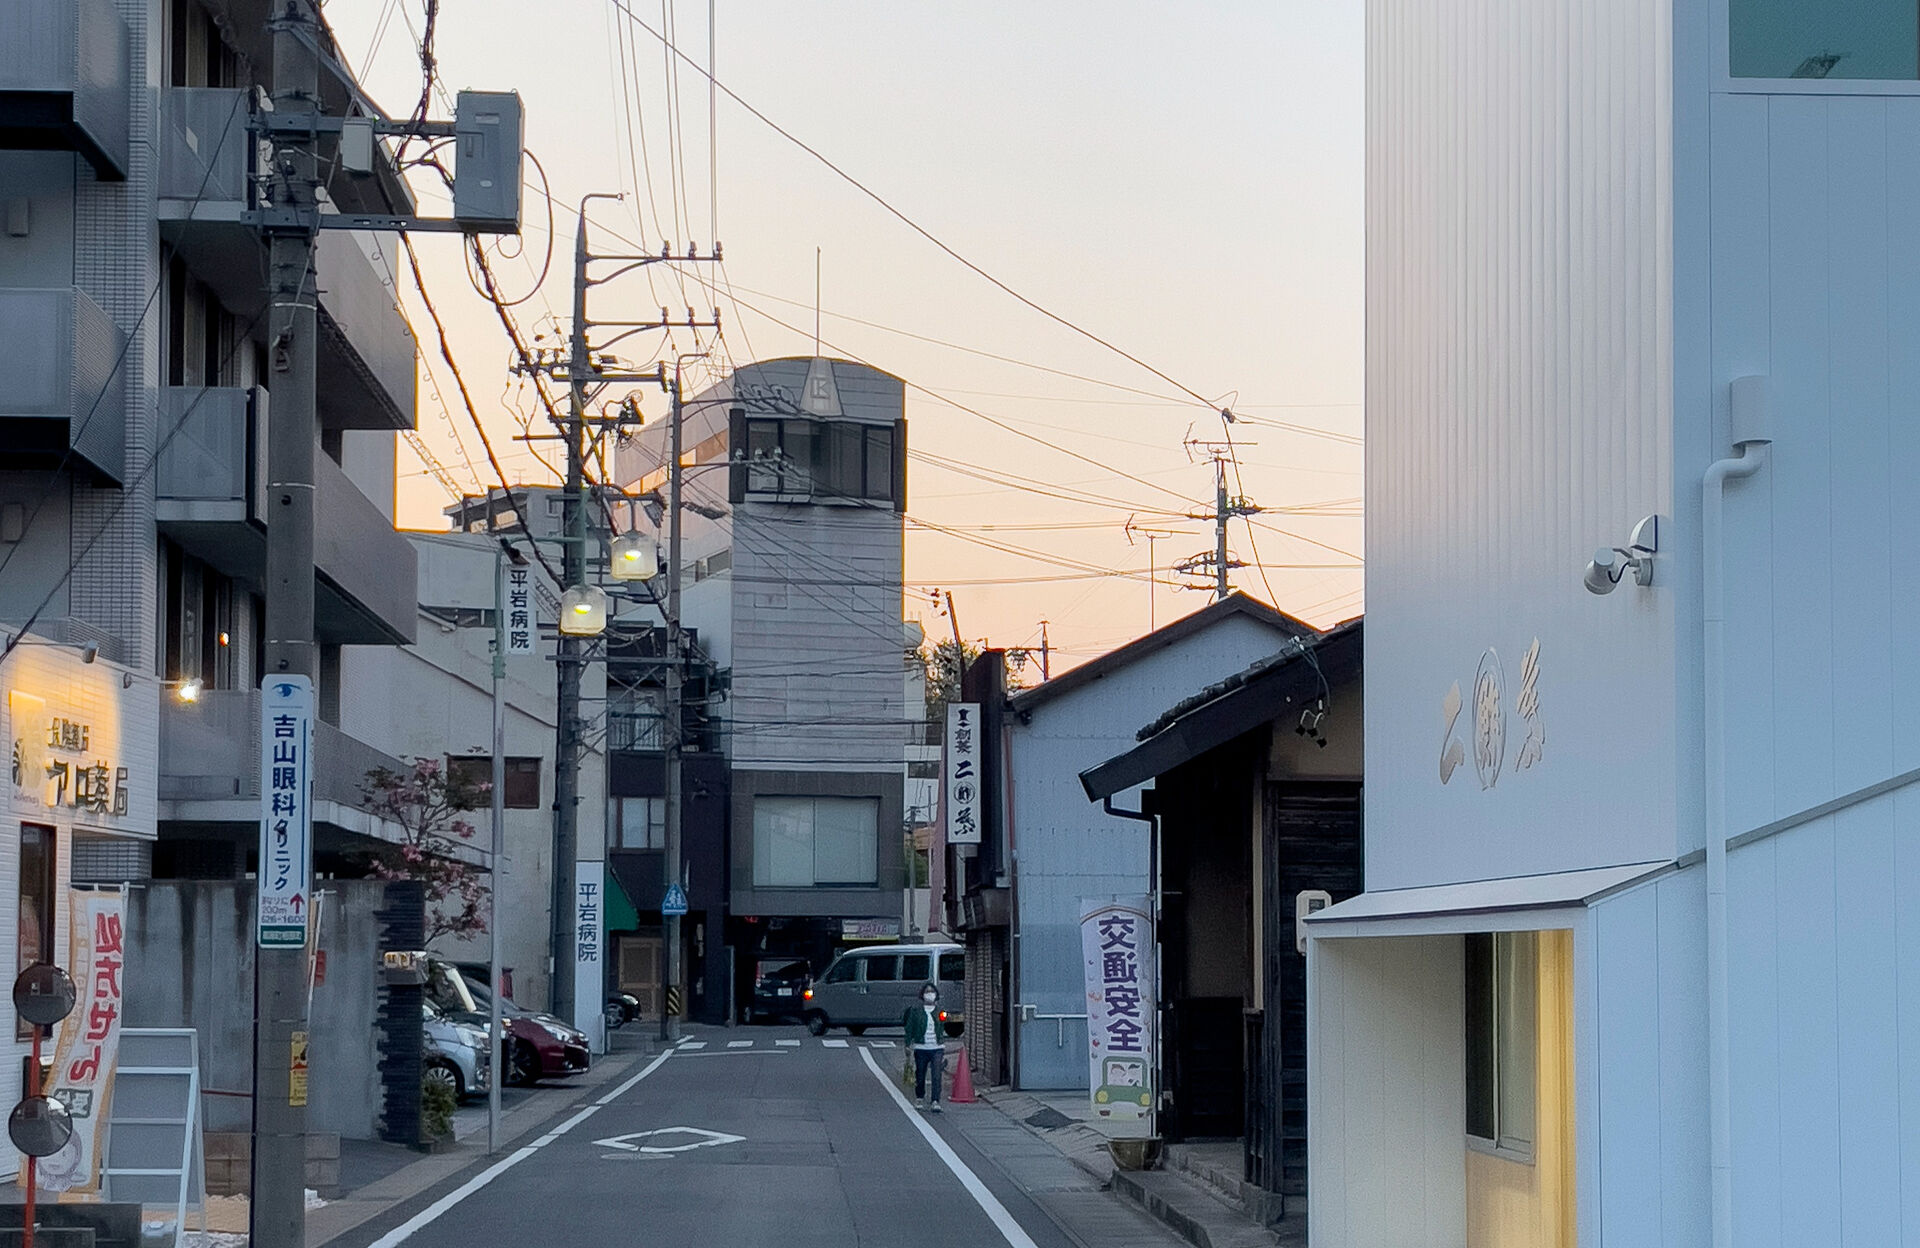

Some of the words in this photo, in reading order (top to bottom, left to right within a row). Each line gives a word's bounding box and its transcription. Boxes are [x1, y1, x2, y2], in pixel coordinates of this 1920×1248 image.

[509, 569, 530, 649] 平岩病院
[577, 882, 598, 962] 平岩病院
